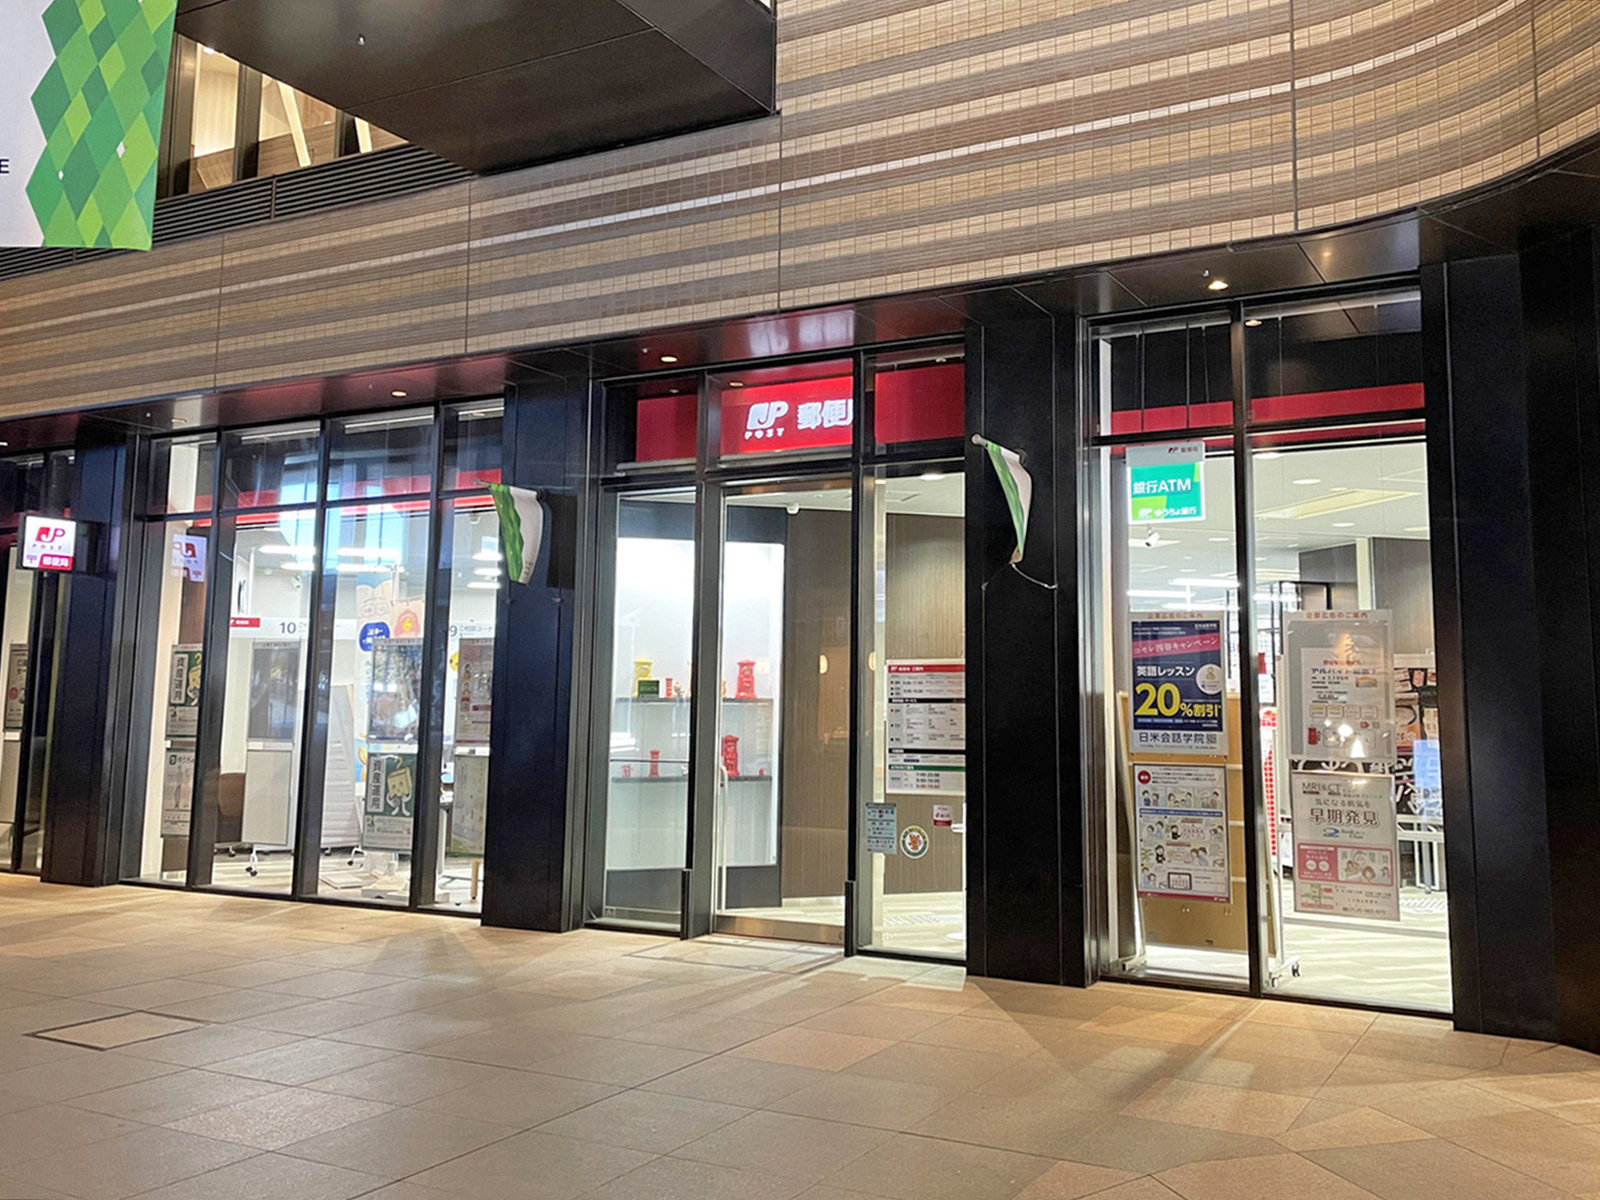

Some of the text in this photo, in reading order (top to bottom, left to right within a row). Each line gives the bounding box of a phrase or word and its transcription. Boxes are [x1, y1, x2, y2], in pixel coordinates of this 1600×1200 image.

[797, 398, 853, 430] 郵便
[744, 427, 785, 440] POST
[1133, 478, 1191, 494] 銀行ATM
[1154, 506, 1197, 517] ゆうちょ銀行
[280, 622, 297, 634] 10
[449, 625, 458, 637] 9
[1136, 666, 1195, 677] 英語レッスン
[1139, 732, 1205, 744] 日米会話学院
[1310, 808, 1378, 826] 早期発見
